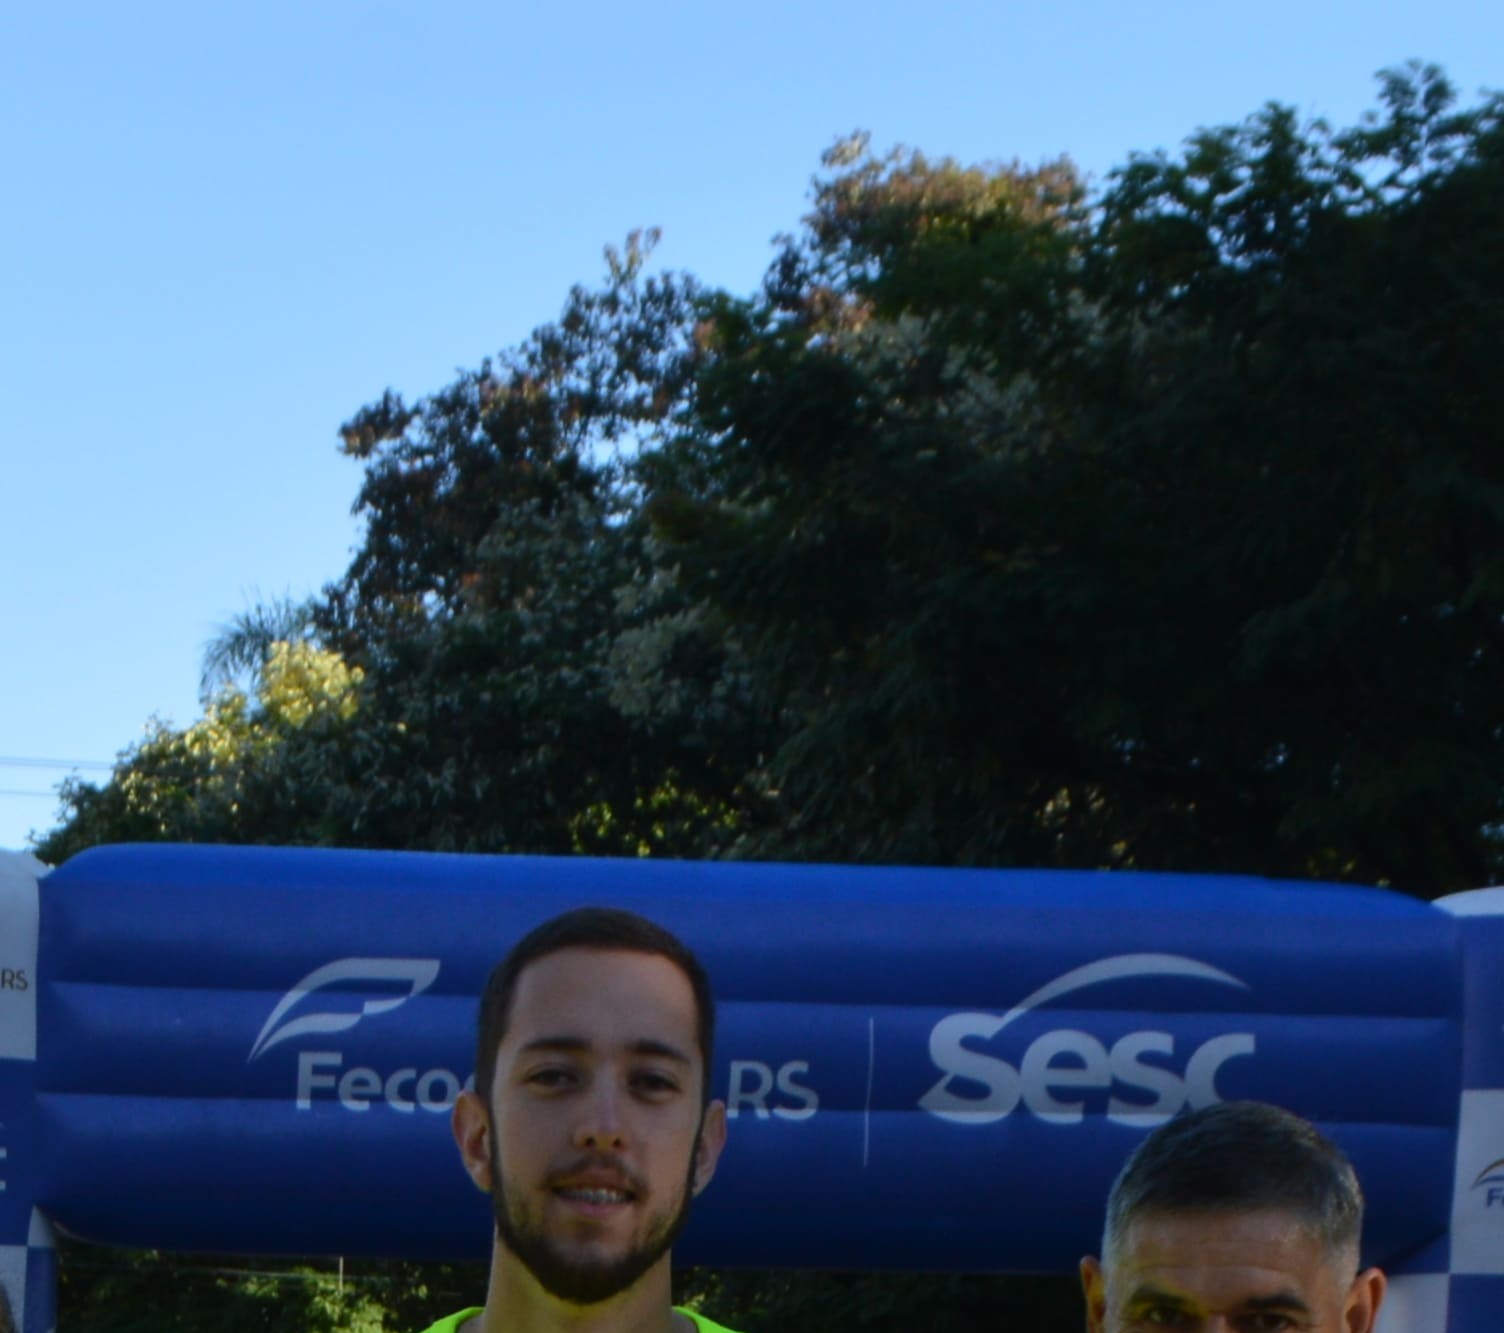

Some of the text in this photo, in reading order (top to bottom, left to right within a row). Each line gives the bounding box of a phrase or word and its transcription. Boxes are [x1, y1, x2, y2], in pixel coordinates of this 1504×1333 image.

[0, 969, 29, 991] RS
[728, 1060, 819, 1120] RS
[918, 1011, 1256, 1127] Sesc
